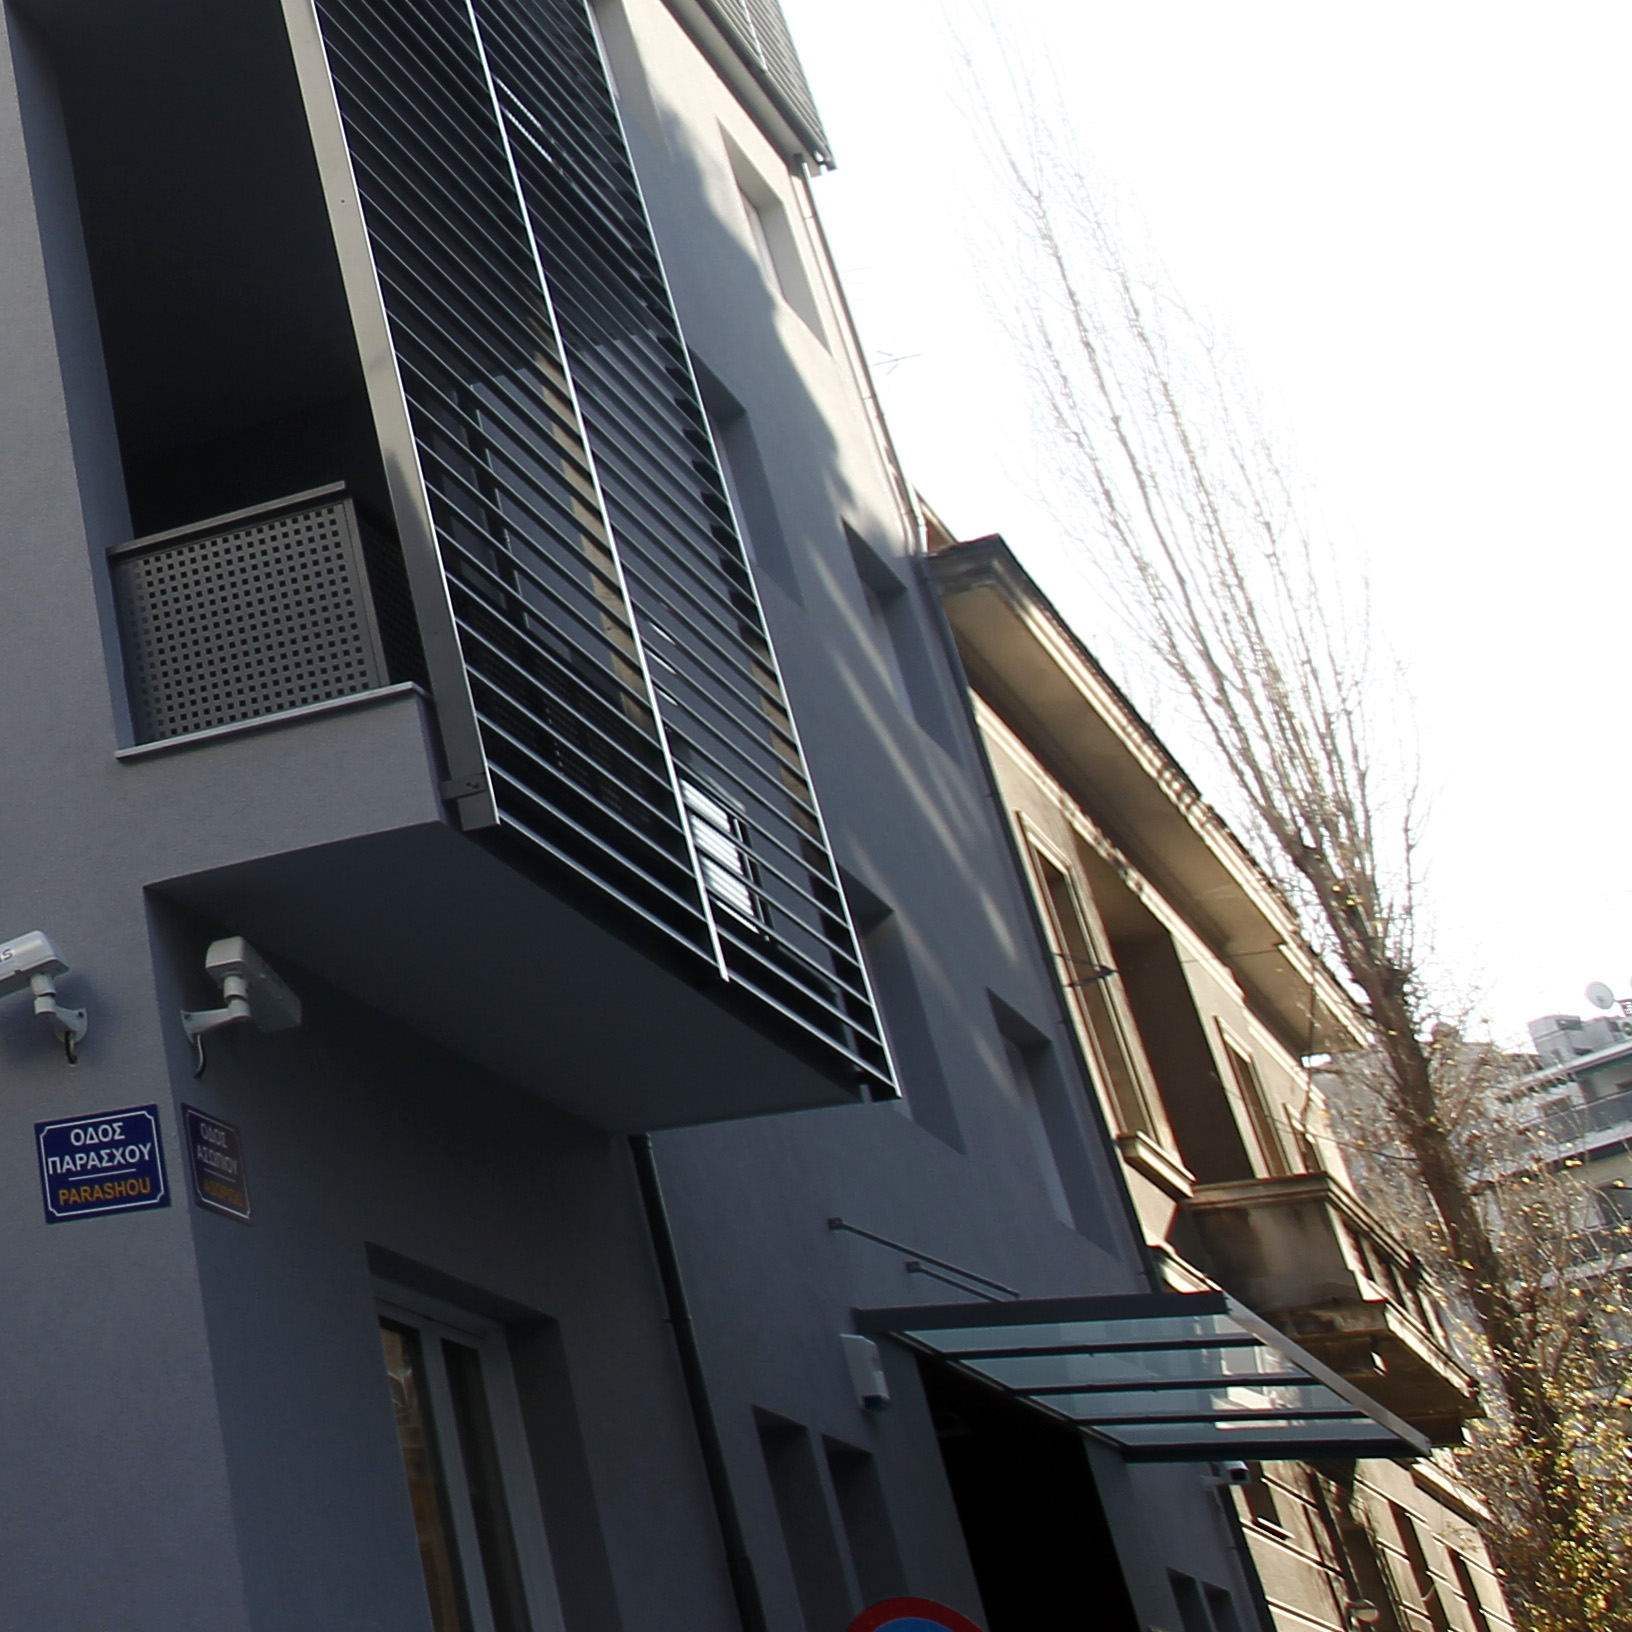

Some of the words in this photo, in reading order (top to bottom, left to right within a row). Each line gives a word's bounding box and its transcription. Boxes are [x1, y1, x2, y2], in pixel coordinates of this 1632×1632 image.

[70, 1122, 126, 1146] ΟΔΟΣ
[47, 1143, 152, 1175] ΠΑΡΑΣΧΟΥ
[58, 1177, 152, 1206] PARASHOU
